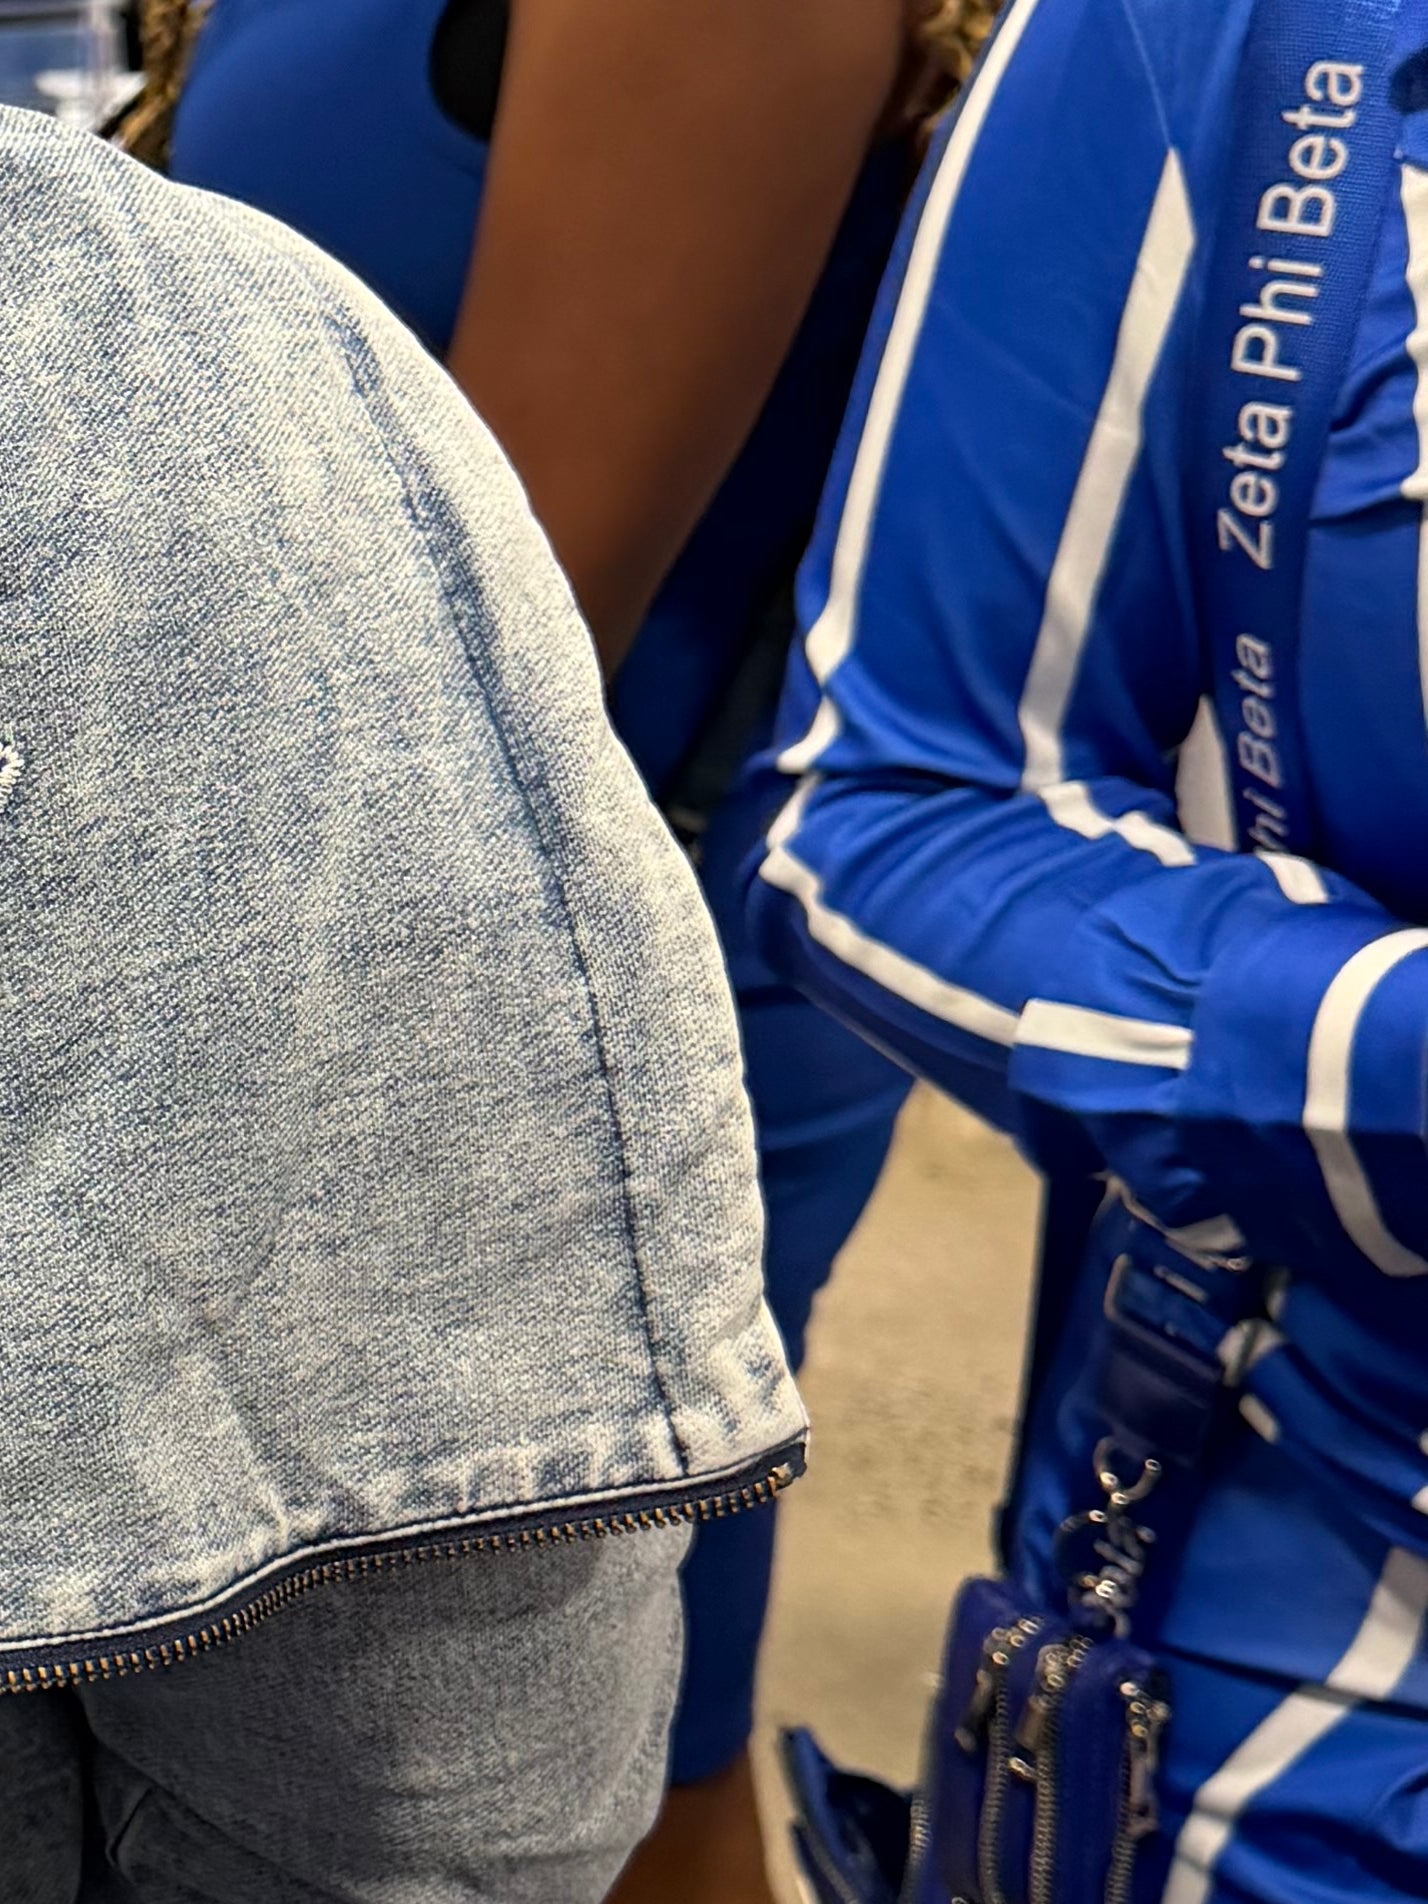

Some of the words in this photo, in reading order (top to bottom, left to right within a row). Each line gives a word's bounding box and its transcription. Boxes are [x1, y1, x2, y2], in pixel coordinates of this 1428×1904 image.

[1255, 58, 1365, 239] Beta
[1230, 255, 1325, 383] Phi
[1216, 399, 1294, 571] Zeta
[1232, 631, 1284, 788] Beta
